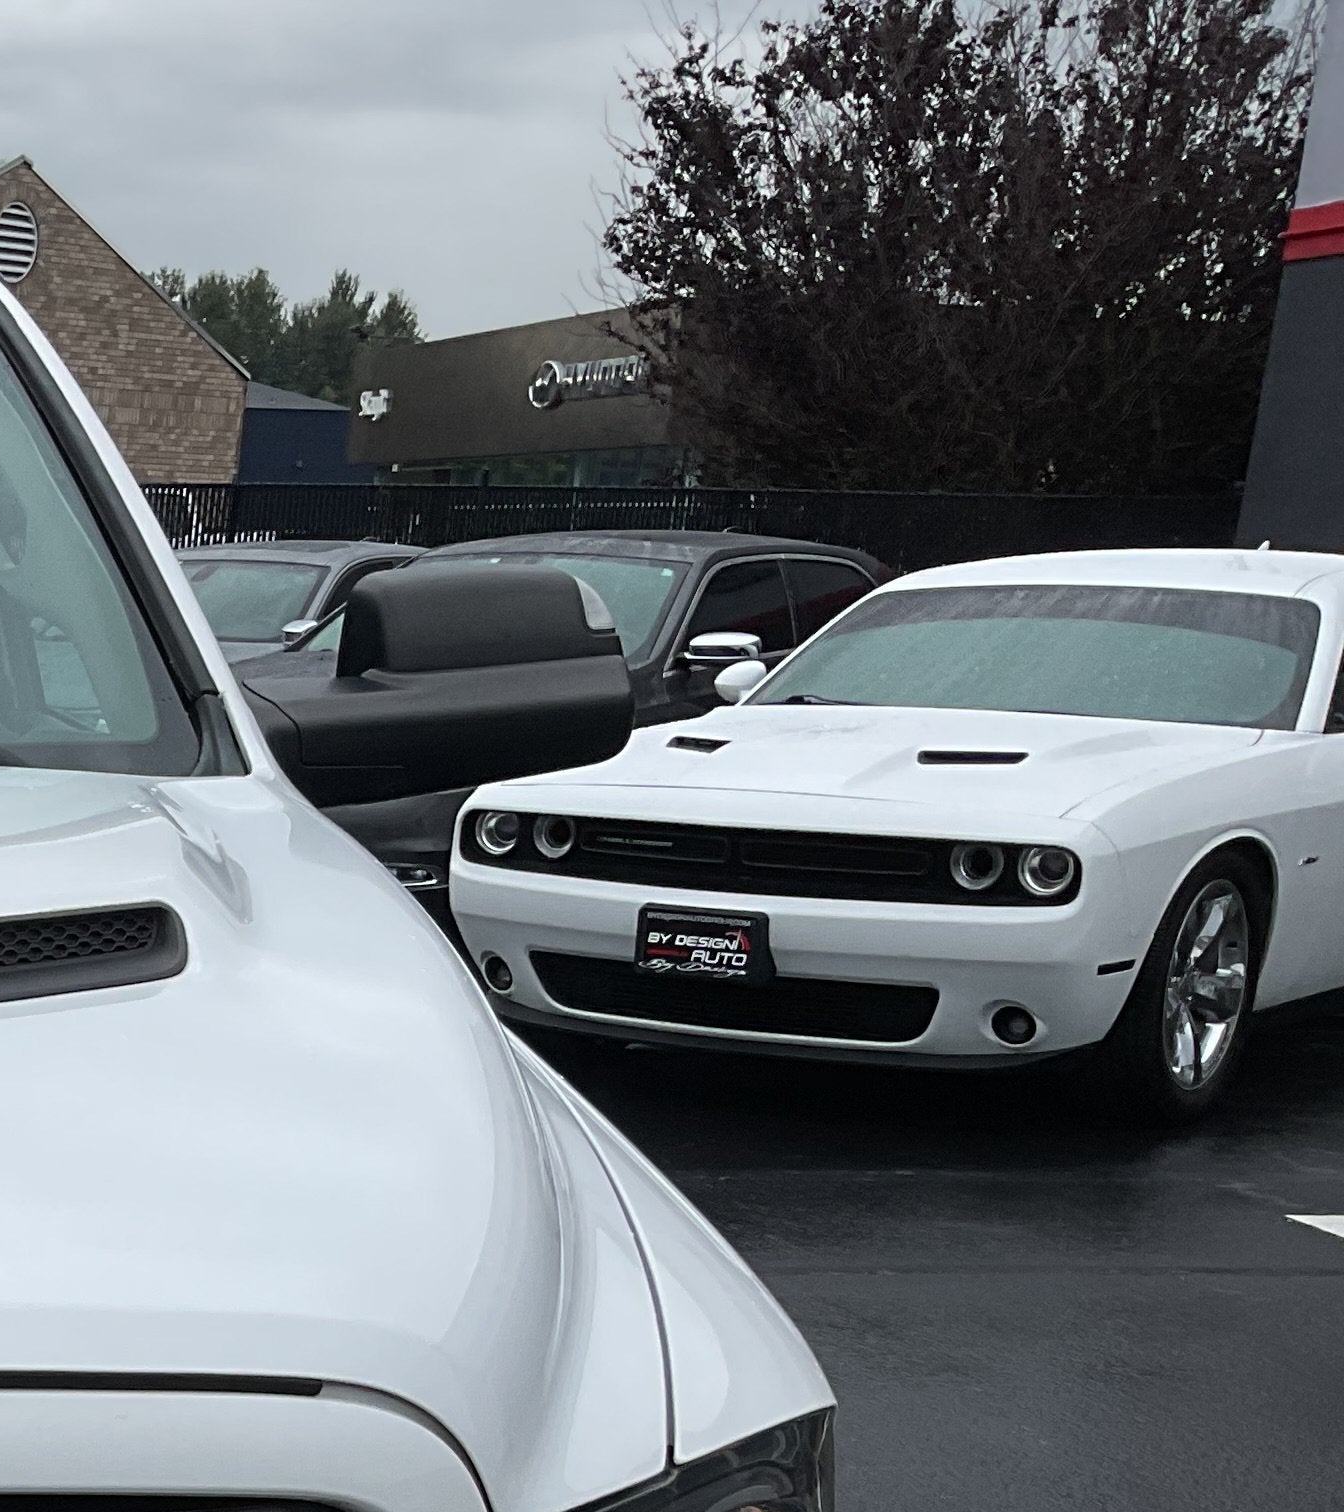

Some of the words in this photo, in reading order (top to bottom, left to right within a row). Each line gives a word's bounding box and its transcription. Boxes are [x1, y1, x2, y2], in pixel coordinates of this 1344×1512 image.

[647, 932, 672, 944] BY
[674, 934, 737, 950] DESIGN
[690, 950, 748, 966] AUTO
